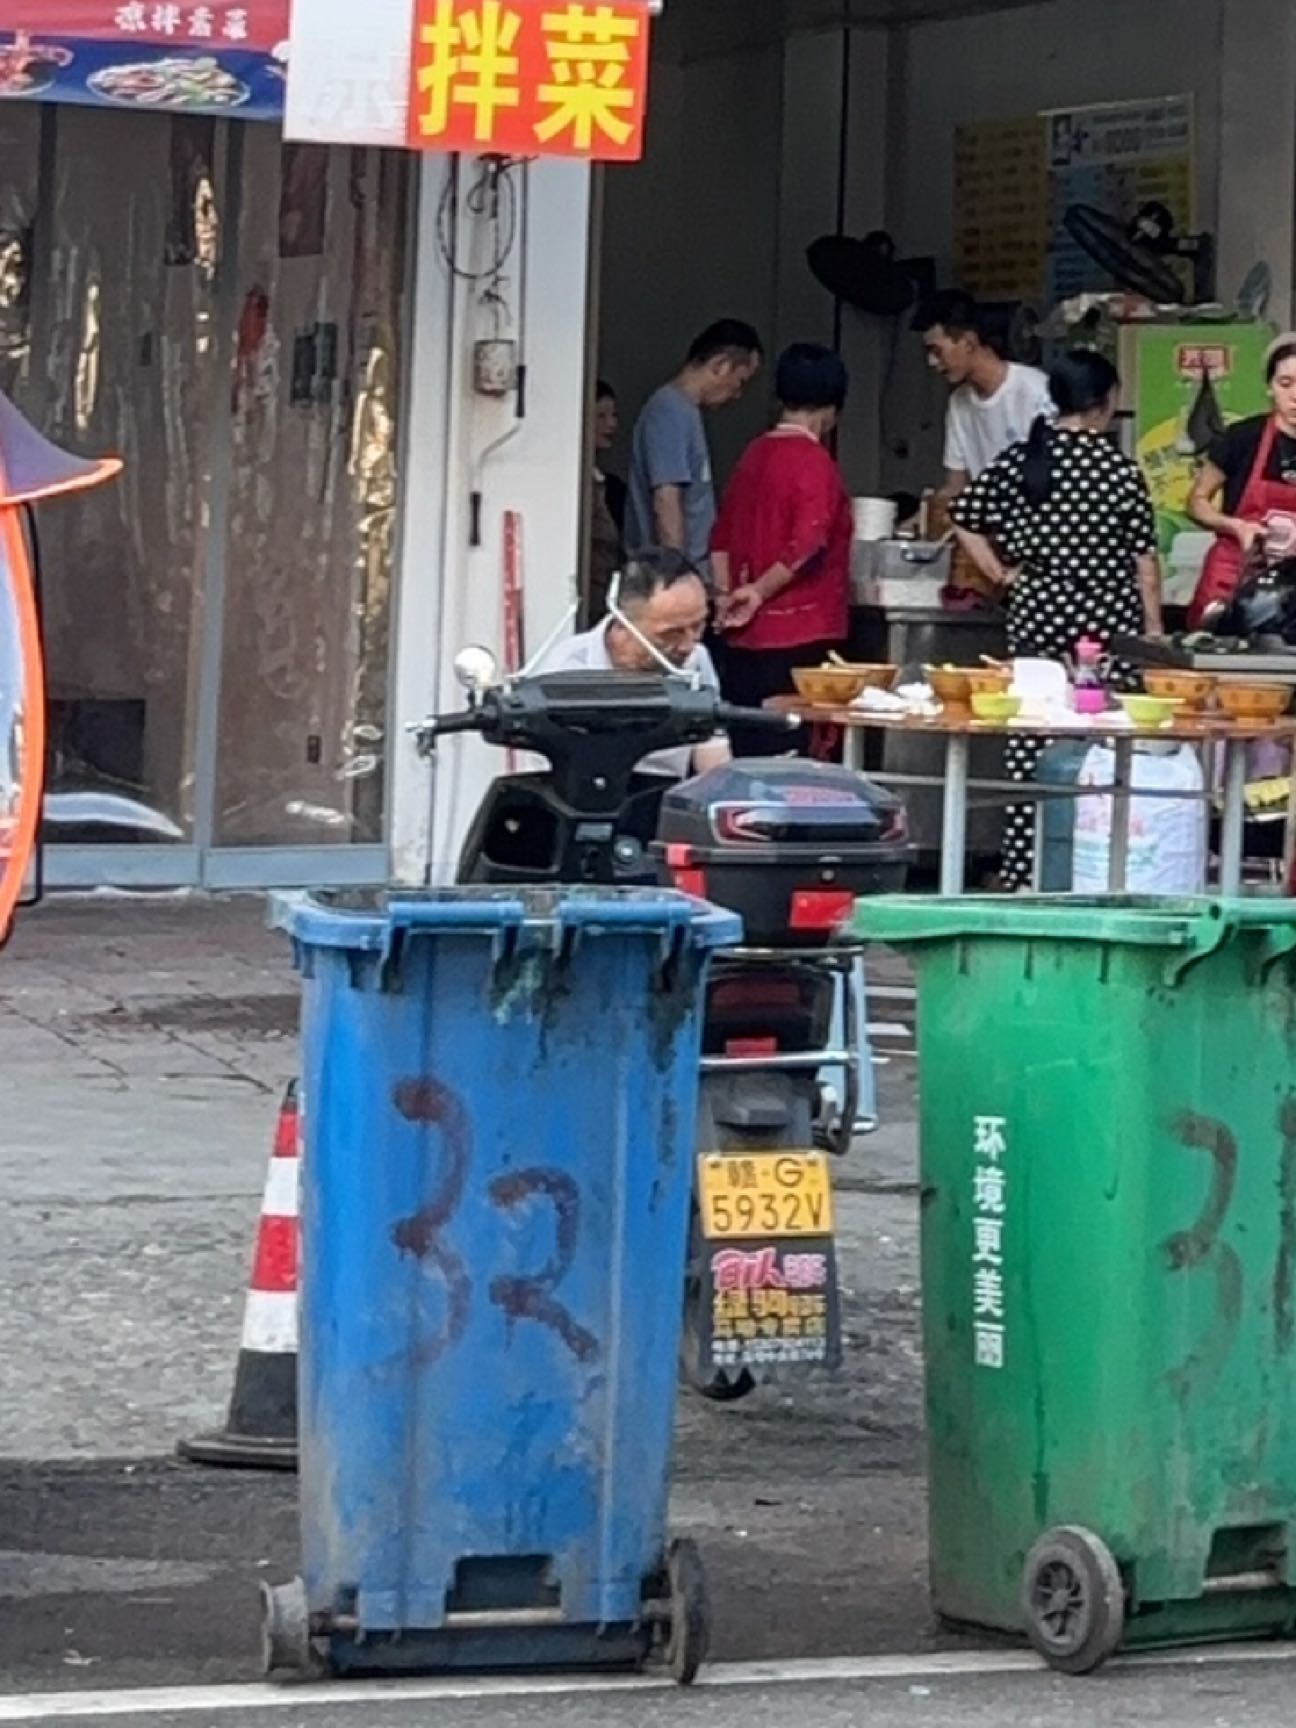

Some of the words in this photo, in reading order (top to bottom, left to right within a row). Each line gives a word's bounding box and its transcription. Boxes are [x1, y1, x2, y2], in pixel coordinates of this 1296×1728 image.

[712, 1193, 824, 1232] 5932V
[973, 1114, 1007, 1369] 环境更美丽
